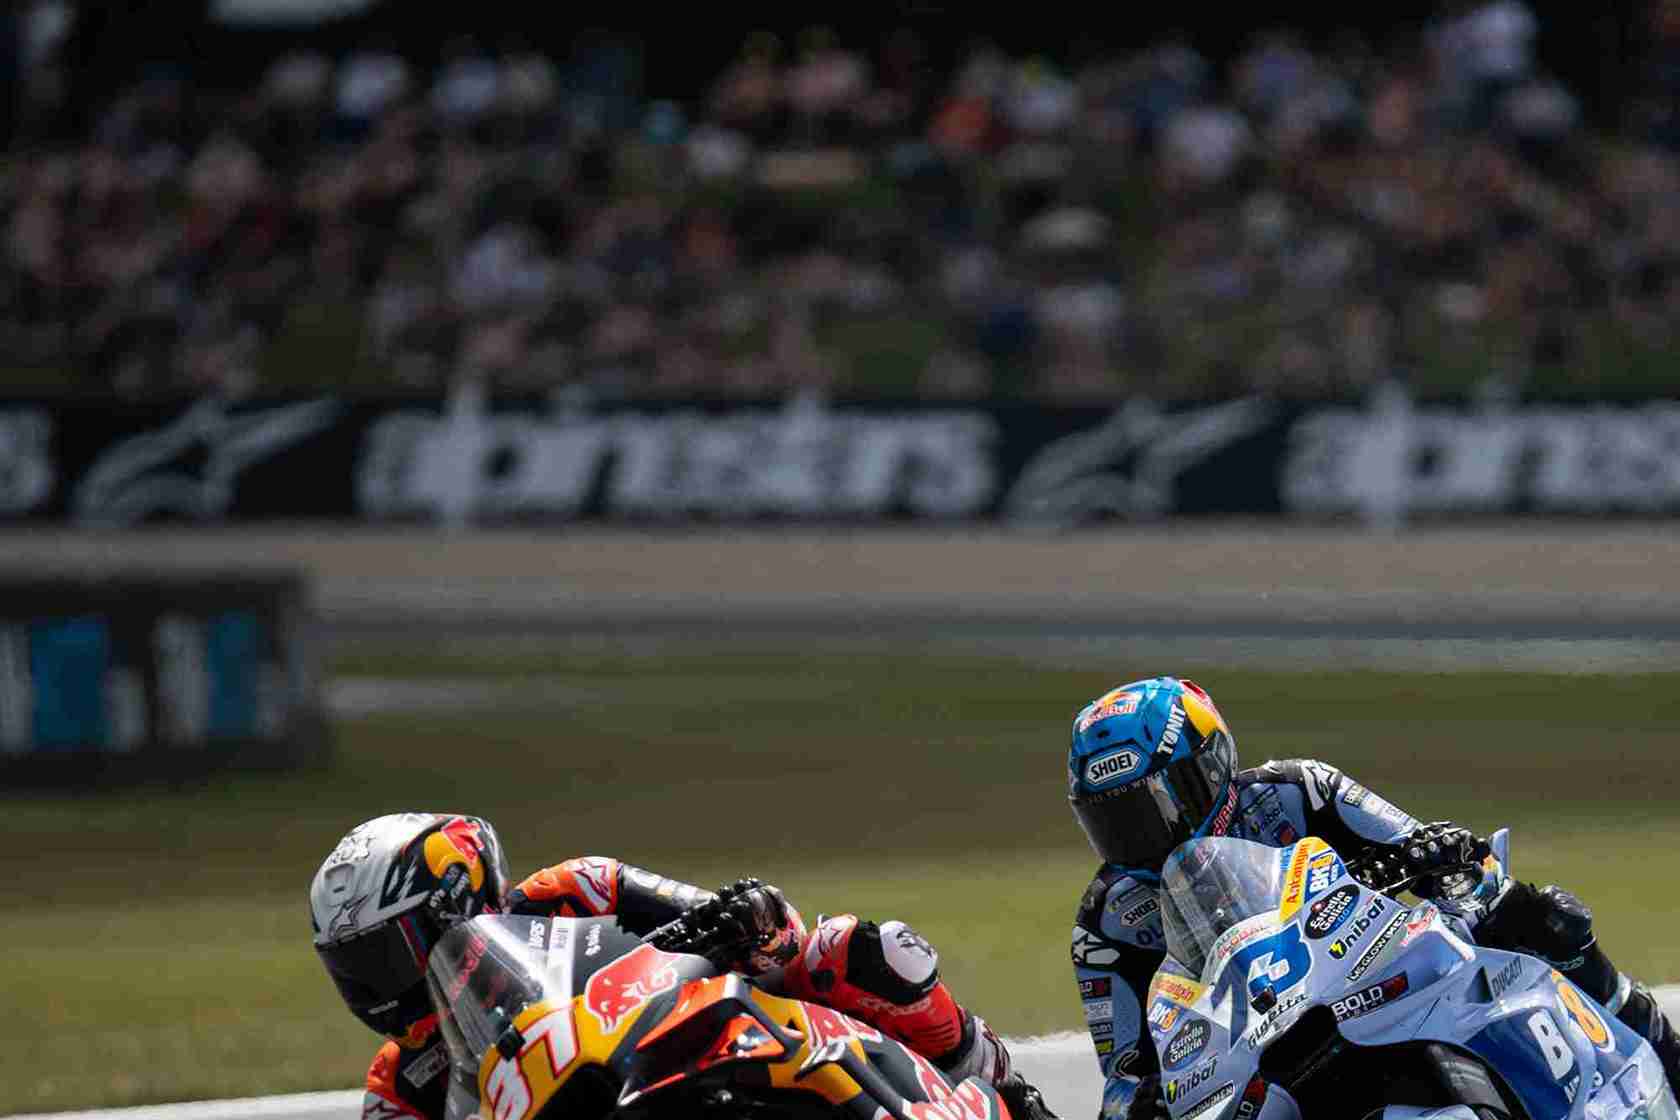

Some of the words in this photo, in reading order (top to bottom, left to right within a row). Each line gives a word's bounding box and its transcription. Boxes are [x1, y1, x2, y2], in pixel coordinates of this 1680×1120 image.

[1090, 753, 1133, 780] SHOEI
[1310, 890, 1347, 930] Estrella
[1319, 895, 1354, 932] Galicia
[1328, 897, 1387, 960] Unibat
[1210, 919, 1312, 1050] 73
[1491, 955, 1523, 995] DUCATI
[1331, 984, 1384, 1016] BOLD
[1166, 1056, 1218, 1105] Unibat
